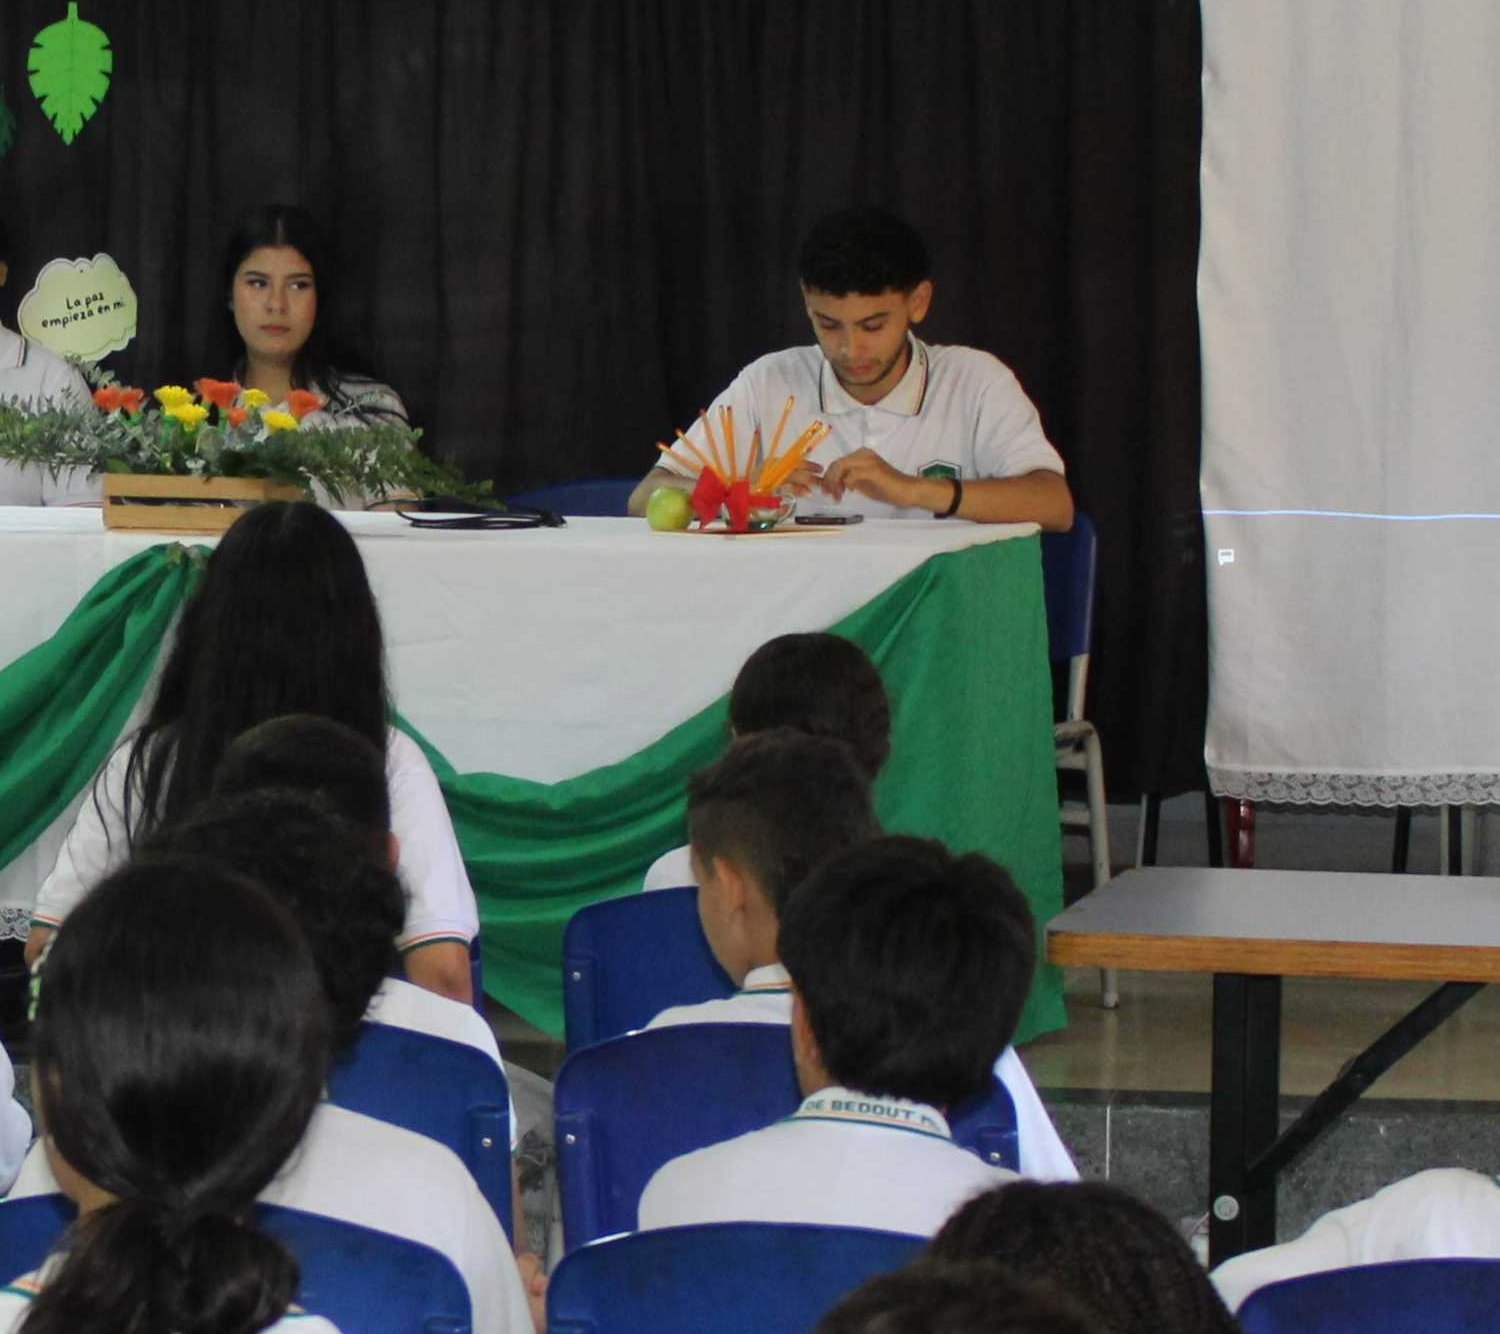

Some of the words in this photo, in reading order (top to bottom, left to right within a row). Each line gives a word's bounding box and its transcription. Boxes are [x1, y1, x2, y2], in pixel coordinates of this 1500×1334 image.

[65, 297, 81, 310] La
[85, 292, 105, 307] paz
[41, 308, 95, 328] empieza
[97, 304, 111, 314] en
[831, 1100, 915, 1120] BEDOUT
